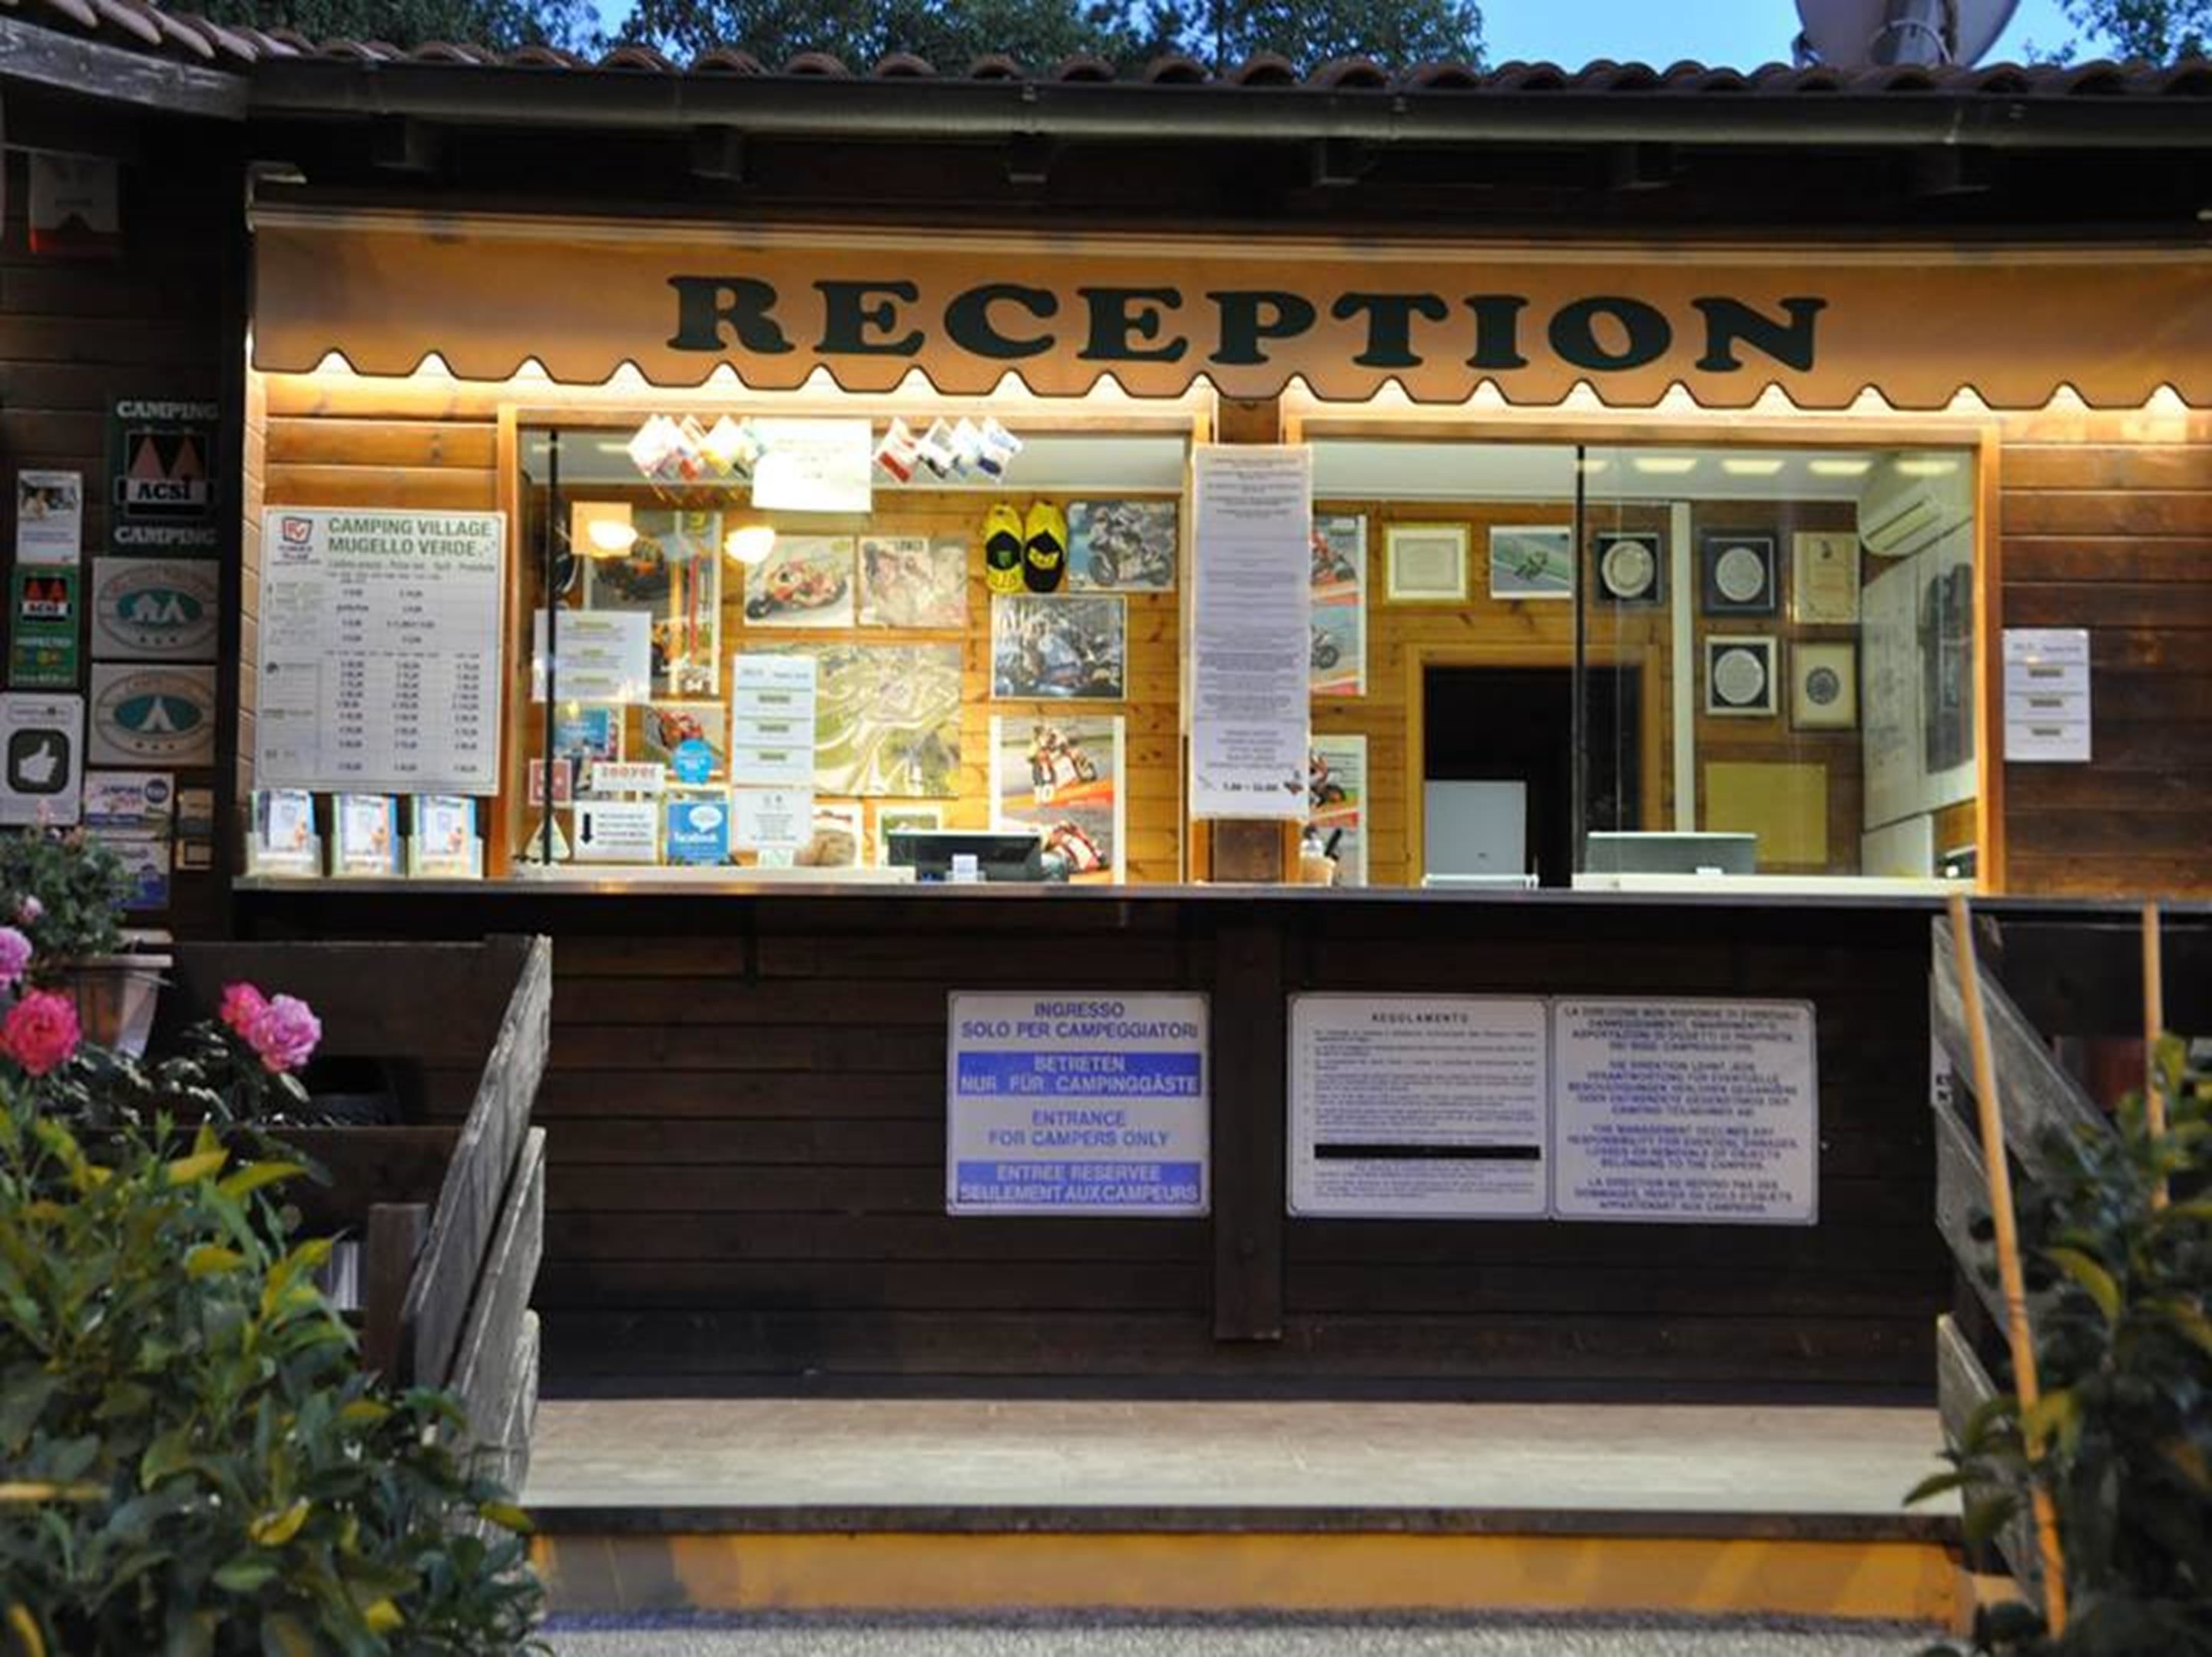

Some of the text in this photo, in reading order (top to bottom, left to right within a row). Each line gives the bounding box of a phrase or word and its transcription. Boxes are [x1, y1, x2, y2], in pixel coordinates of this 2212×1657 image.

[667, 276, 1828, 373] RECEPTION
[117, 400, 219, 419] CAMPING
[137, 482, 191, 499] ACSI
[115, 526, 217, 544] CAMPING
[328, 517, 492, 537] CAMPING VILLAGE
[328, 538, 413, 555] MUGELLO
[418, 539, 476, 556] VERDE
[1034, 1002, 1124, 1018] INGRESSO
[962, 1021, 1198, 1039] SOLO PER CAMPEGGIATORI
[1034, 1056, 1125, 1072] BETRETEN
[960, 1076, 997, 1092] NUR
[1032, 1109, 1126, 1126] ENTRANCE
[988, 1130, 1170, 1147] FOR CAMPERS ONLY
